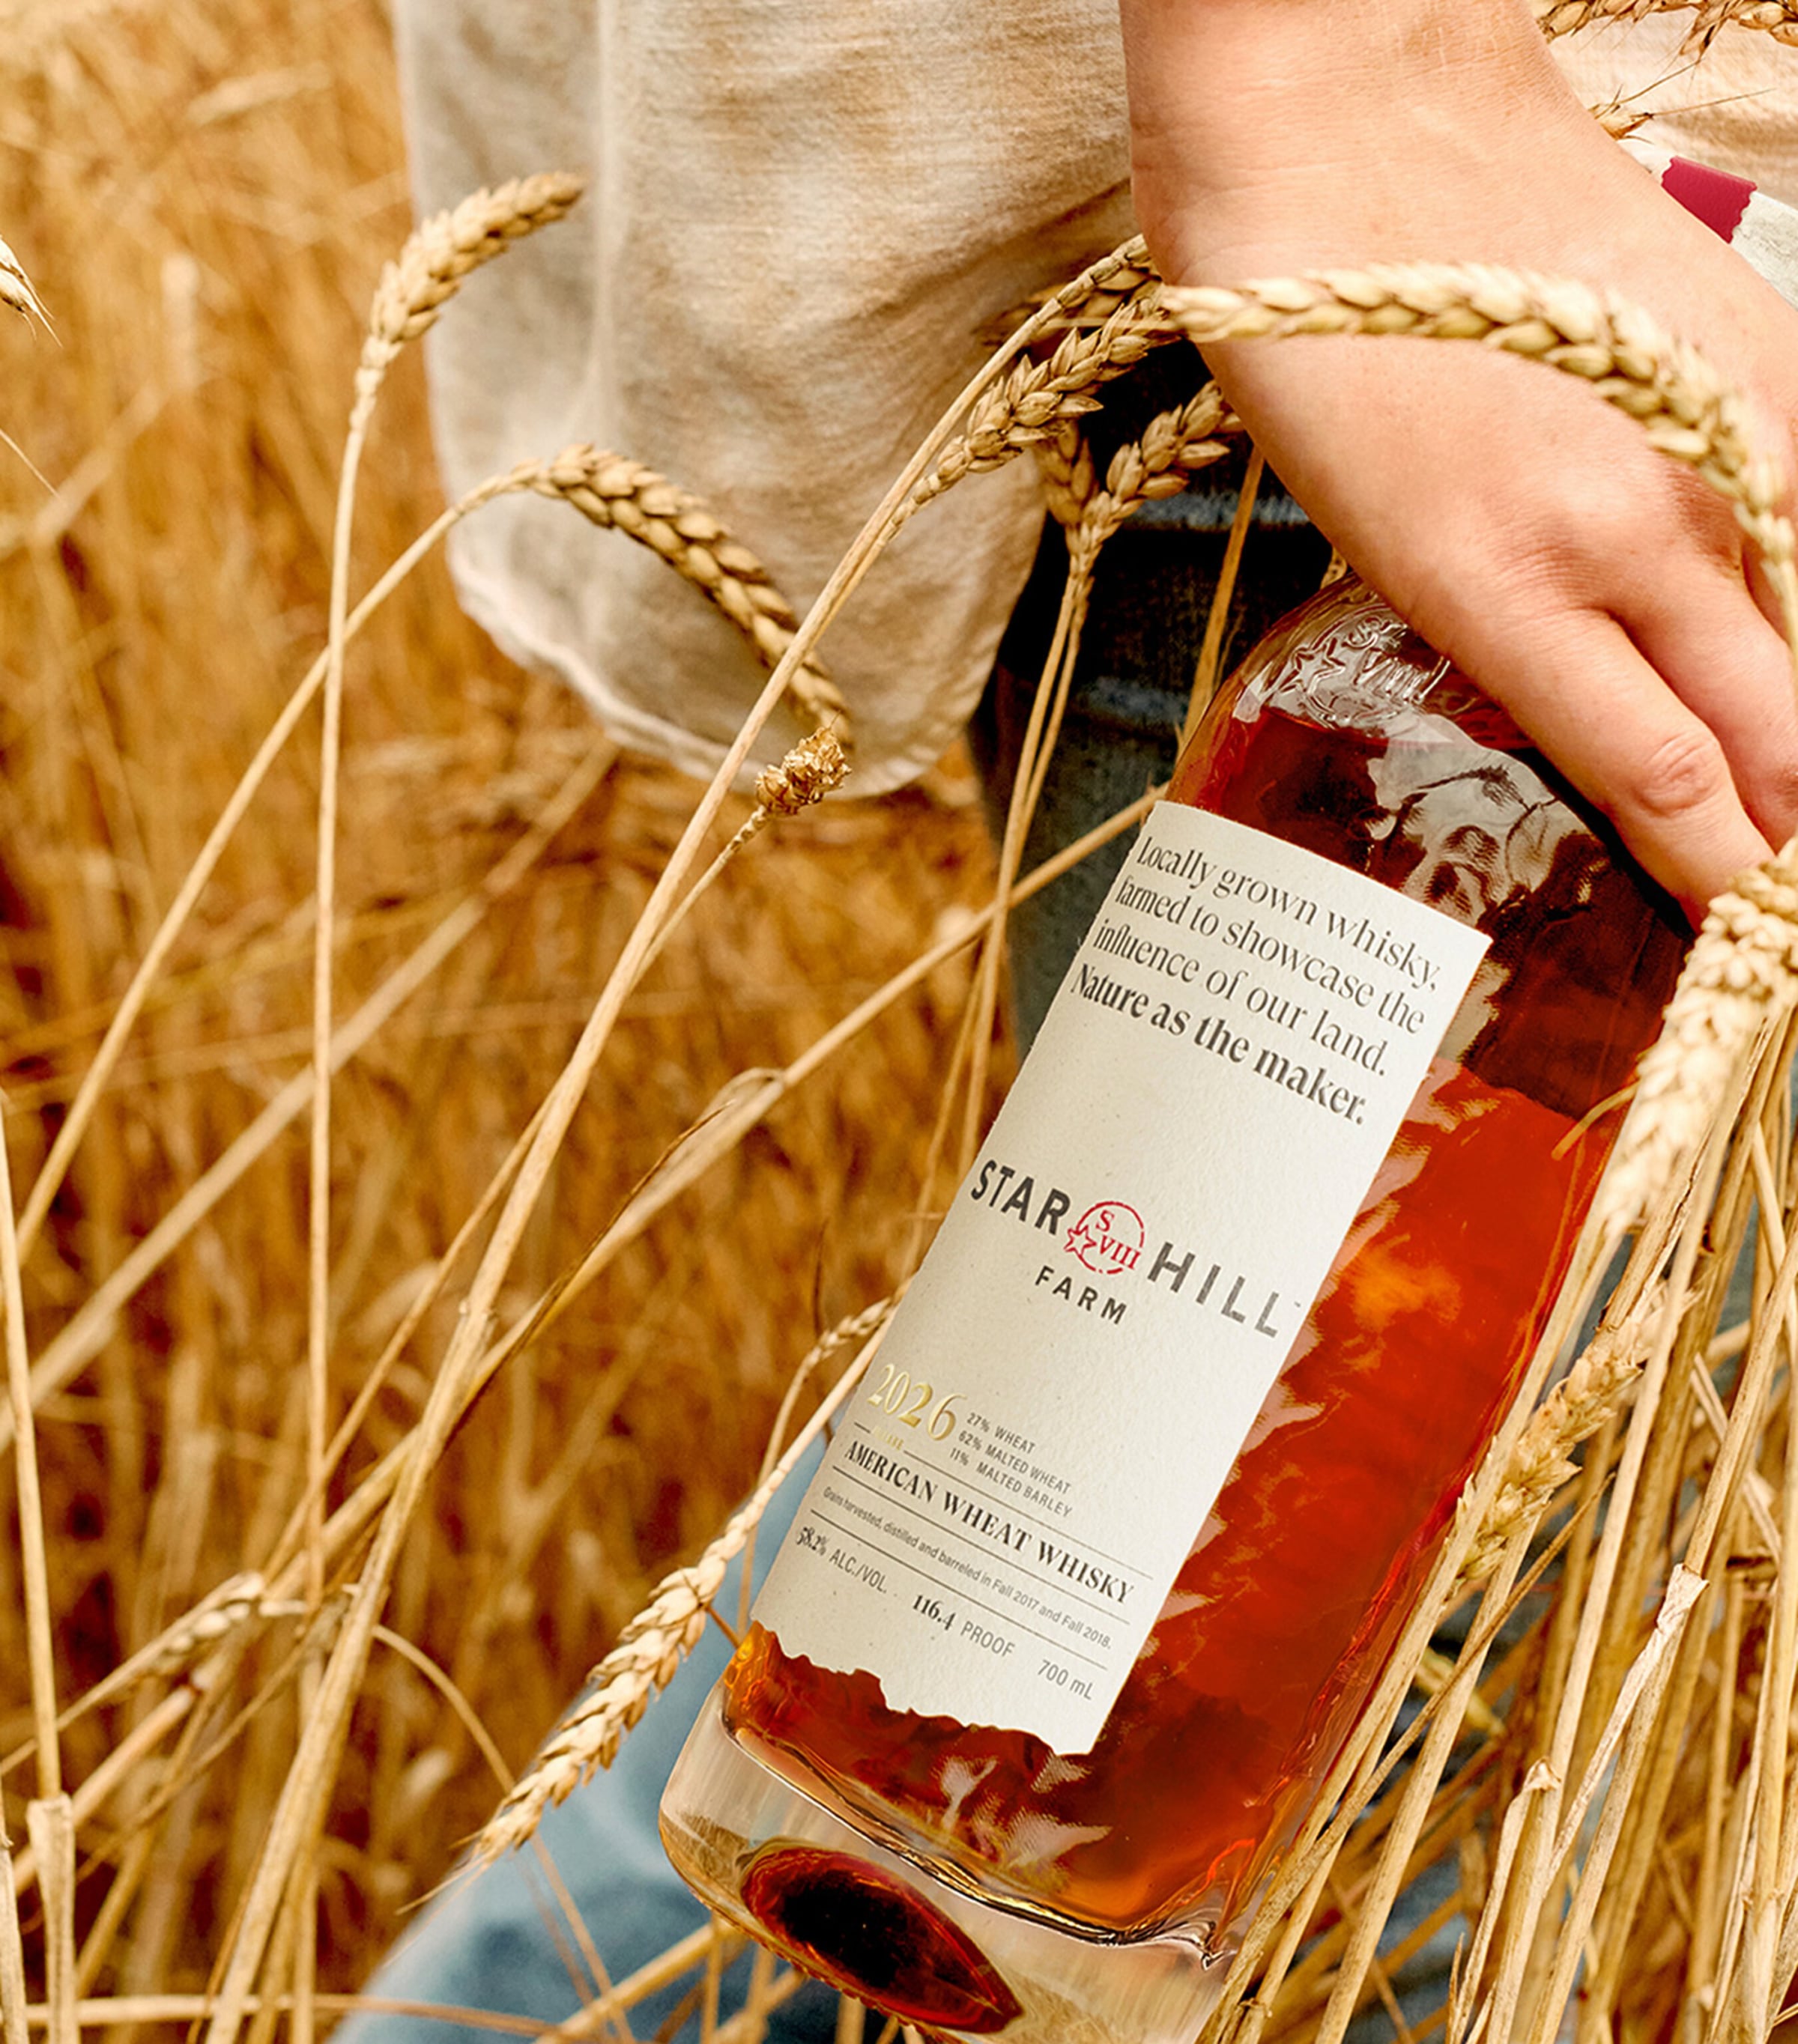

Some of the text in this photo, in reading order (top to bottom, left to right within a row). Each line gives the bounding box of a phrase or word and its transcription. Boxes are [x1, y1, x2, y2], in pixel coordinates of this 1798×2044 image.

[1136, 836, 1441, 992] Locally grown whisky,
[1115, 874, 1424, 1034] farmed to showcase the
[1094, 918, 1387, 1077] influence of our land.
[1070, 963, 1366, 1125] Nature as the maker.
[971, 1159, 1280, 1338] STAR HILL
[1095, 1210, 1115, 1232] S
[1099, 1235, 1141, 1270] VIII
[1035, 1266, 1127, 1325] FARM
[867, 1363, 967, 1441] 2026
[967, 1412, 1035, 1454] 27% WHEAT
[949, 1448, 1073, 1517] 11% MALTED BARLEY
[959, 1431, 1071, 1495] 62% MALTED WHEAT
[844, 1440, 1134, 1604] AMERICAN WHEAT WHISKY
[796, 1526, 887, 1593] 58.2% ALC./VOL.
[884, 1522, 918, 1547] distilled
[918, 1542, 937, 1558] and
[938, 1551, 981, 1580] barreled
[981, 1571, 992, 1586] in
[992, 1577, 1014, 1596] Fall
[1013, 1590, 1039, 1610] 2017
[1039, 1604, 1062, 1622] and
[1062, 1615, 1084, 1634] Fall
[1083, 1626, 1111, 1650] 2018.
[912, 1594, 1015, 1658] 116.4 PROOF
[1038, 1660, 1093, 1700] 700 mL
